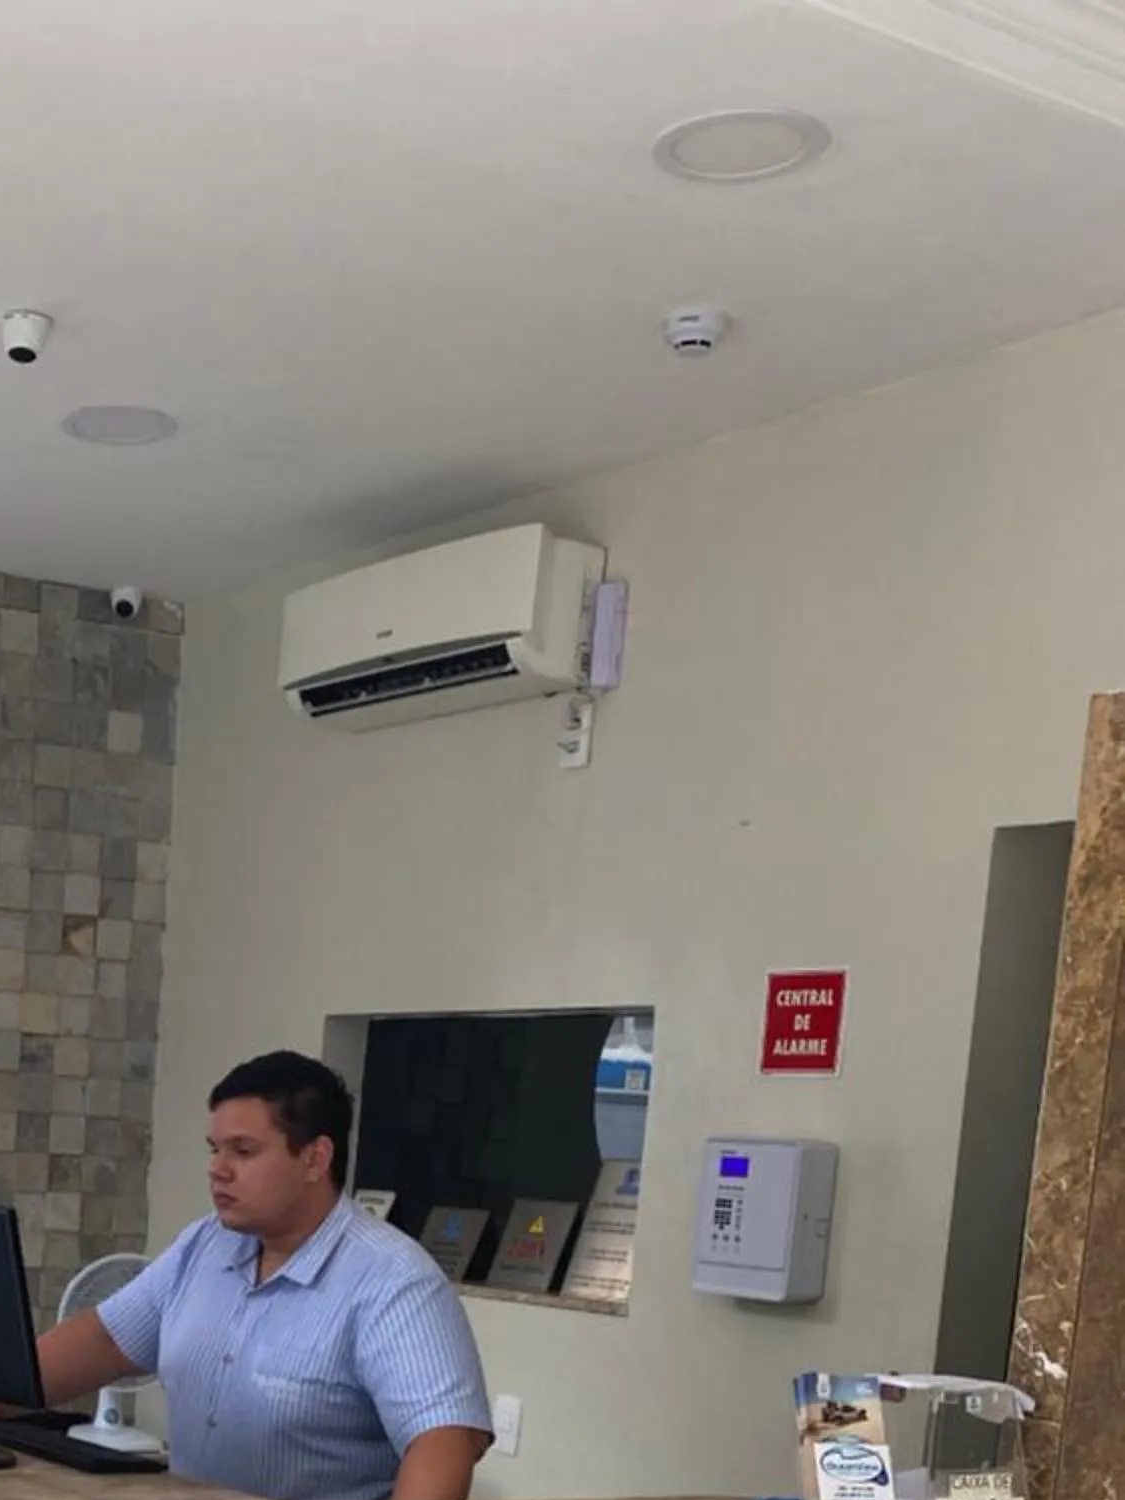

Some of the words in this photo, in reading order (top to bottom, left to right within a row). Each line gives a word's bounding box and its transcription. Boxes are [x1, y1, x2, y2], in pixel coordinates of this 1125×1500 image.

[776, 989, 834, 1006] CENTRAL
[794, 1014, 812, 1031] DE
[773, 1038, 828, 1056] ALARME
[952, 1473, 990, 1489] CAIXA
[994, 1473, 1012, 1488] DE
